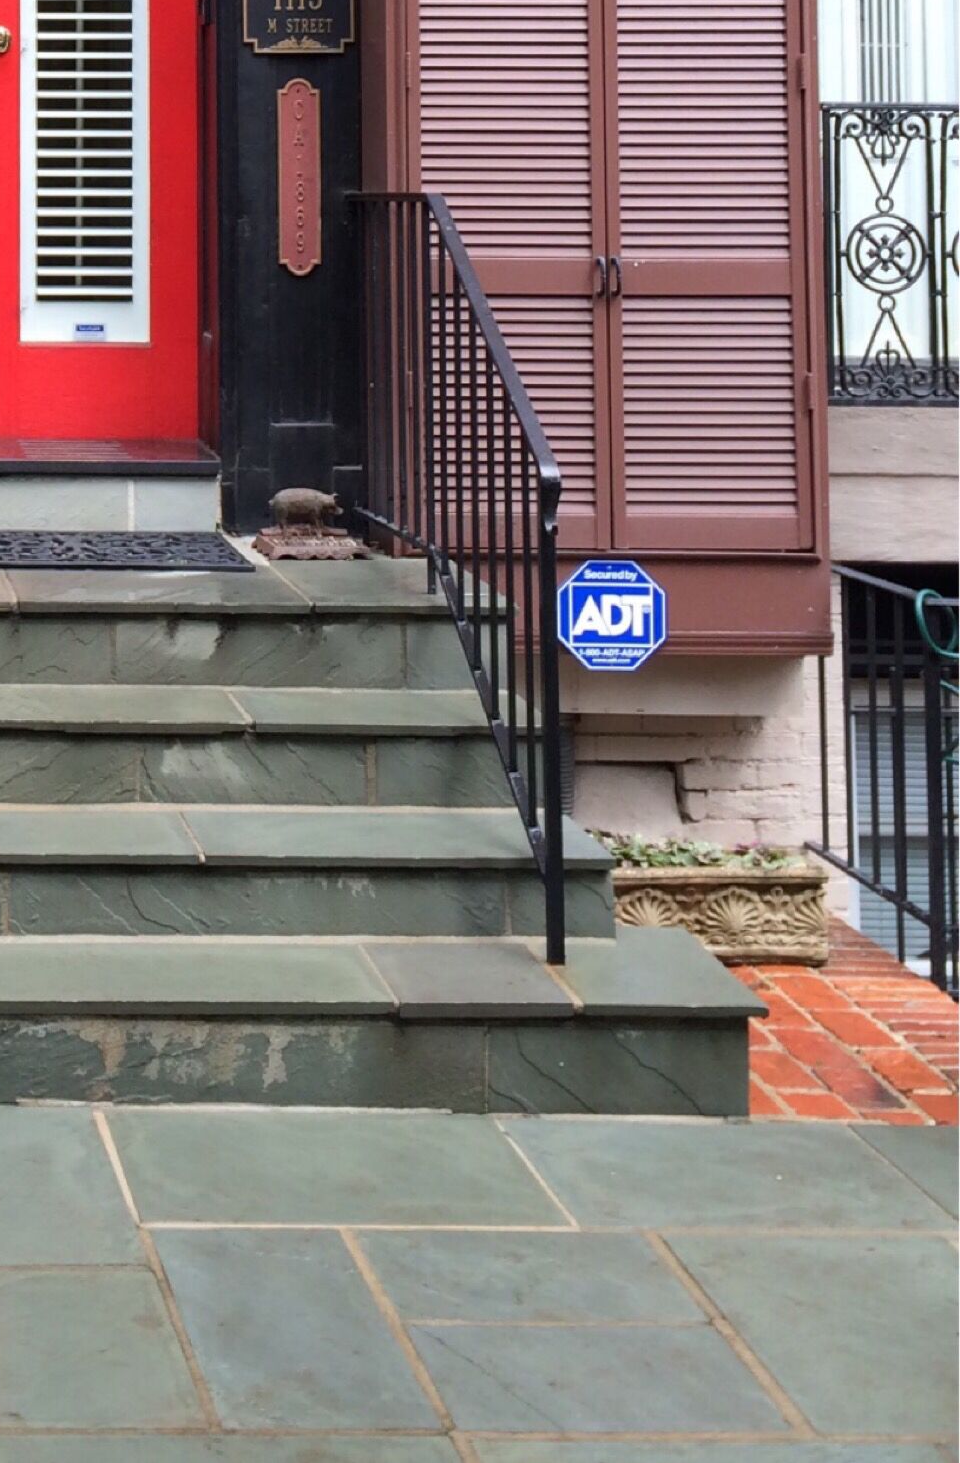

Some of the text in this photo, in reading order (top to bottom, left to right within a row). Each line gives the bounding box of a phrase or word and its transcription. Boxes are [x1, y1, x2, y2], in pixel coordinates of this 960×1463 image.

[267, 17, 334, 34] M STREET
[583, 567, 638, 582] Secured by
[572, 594, 652, 637] ADT
